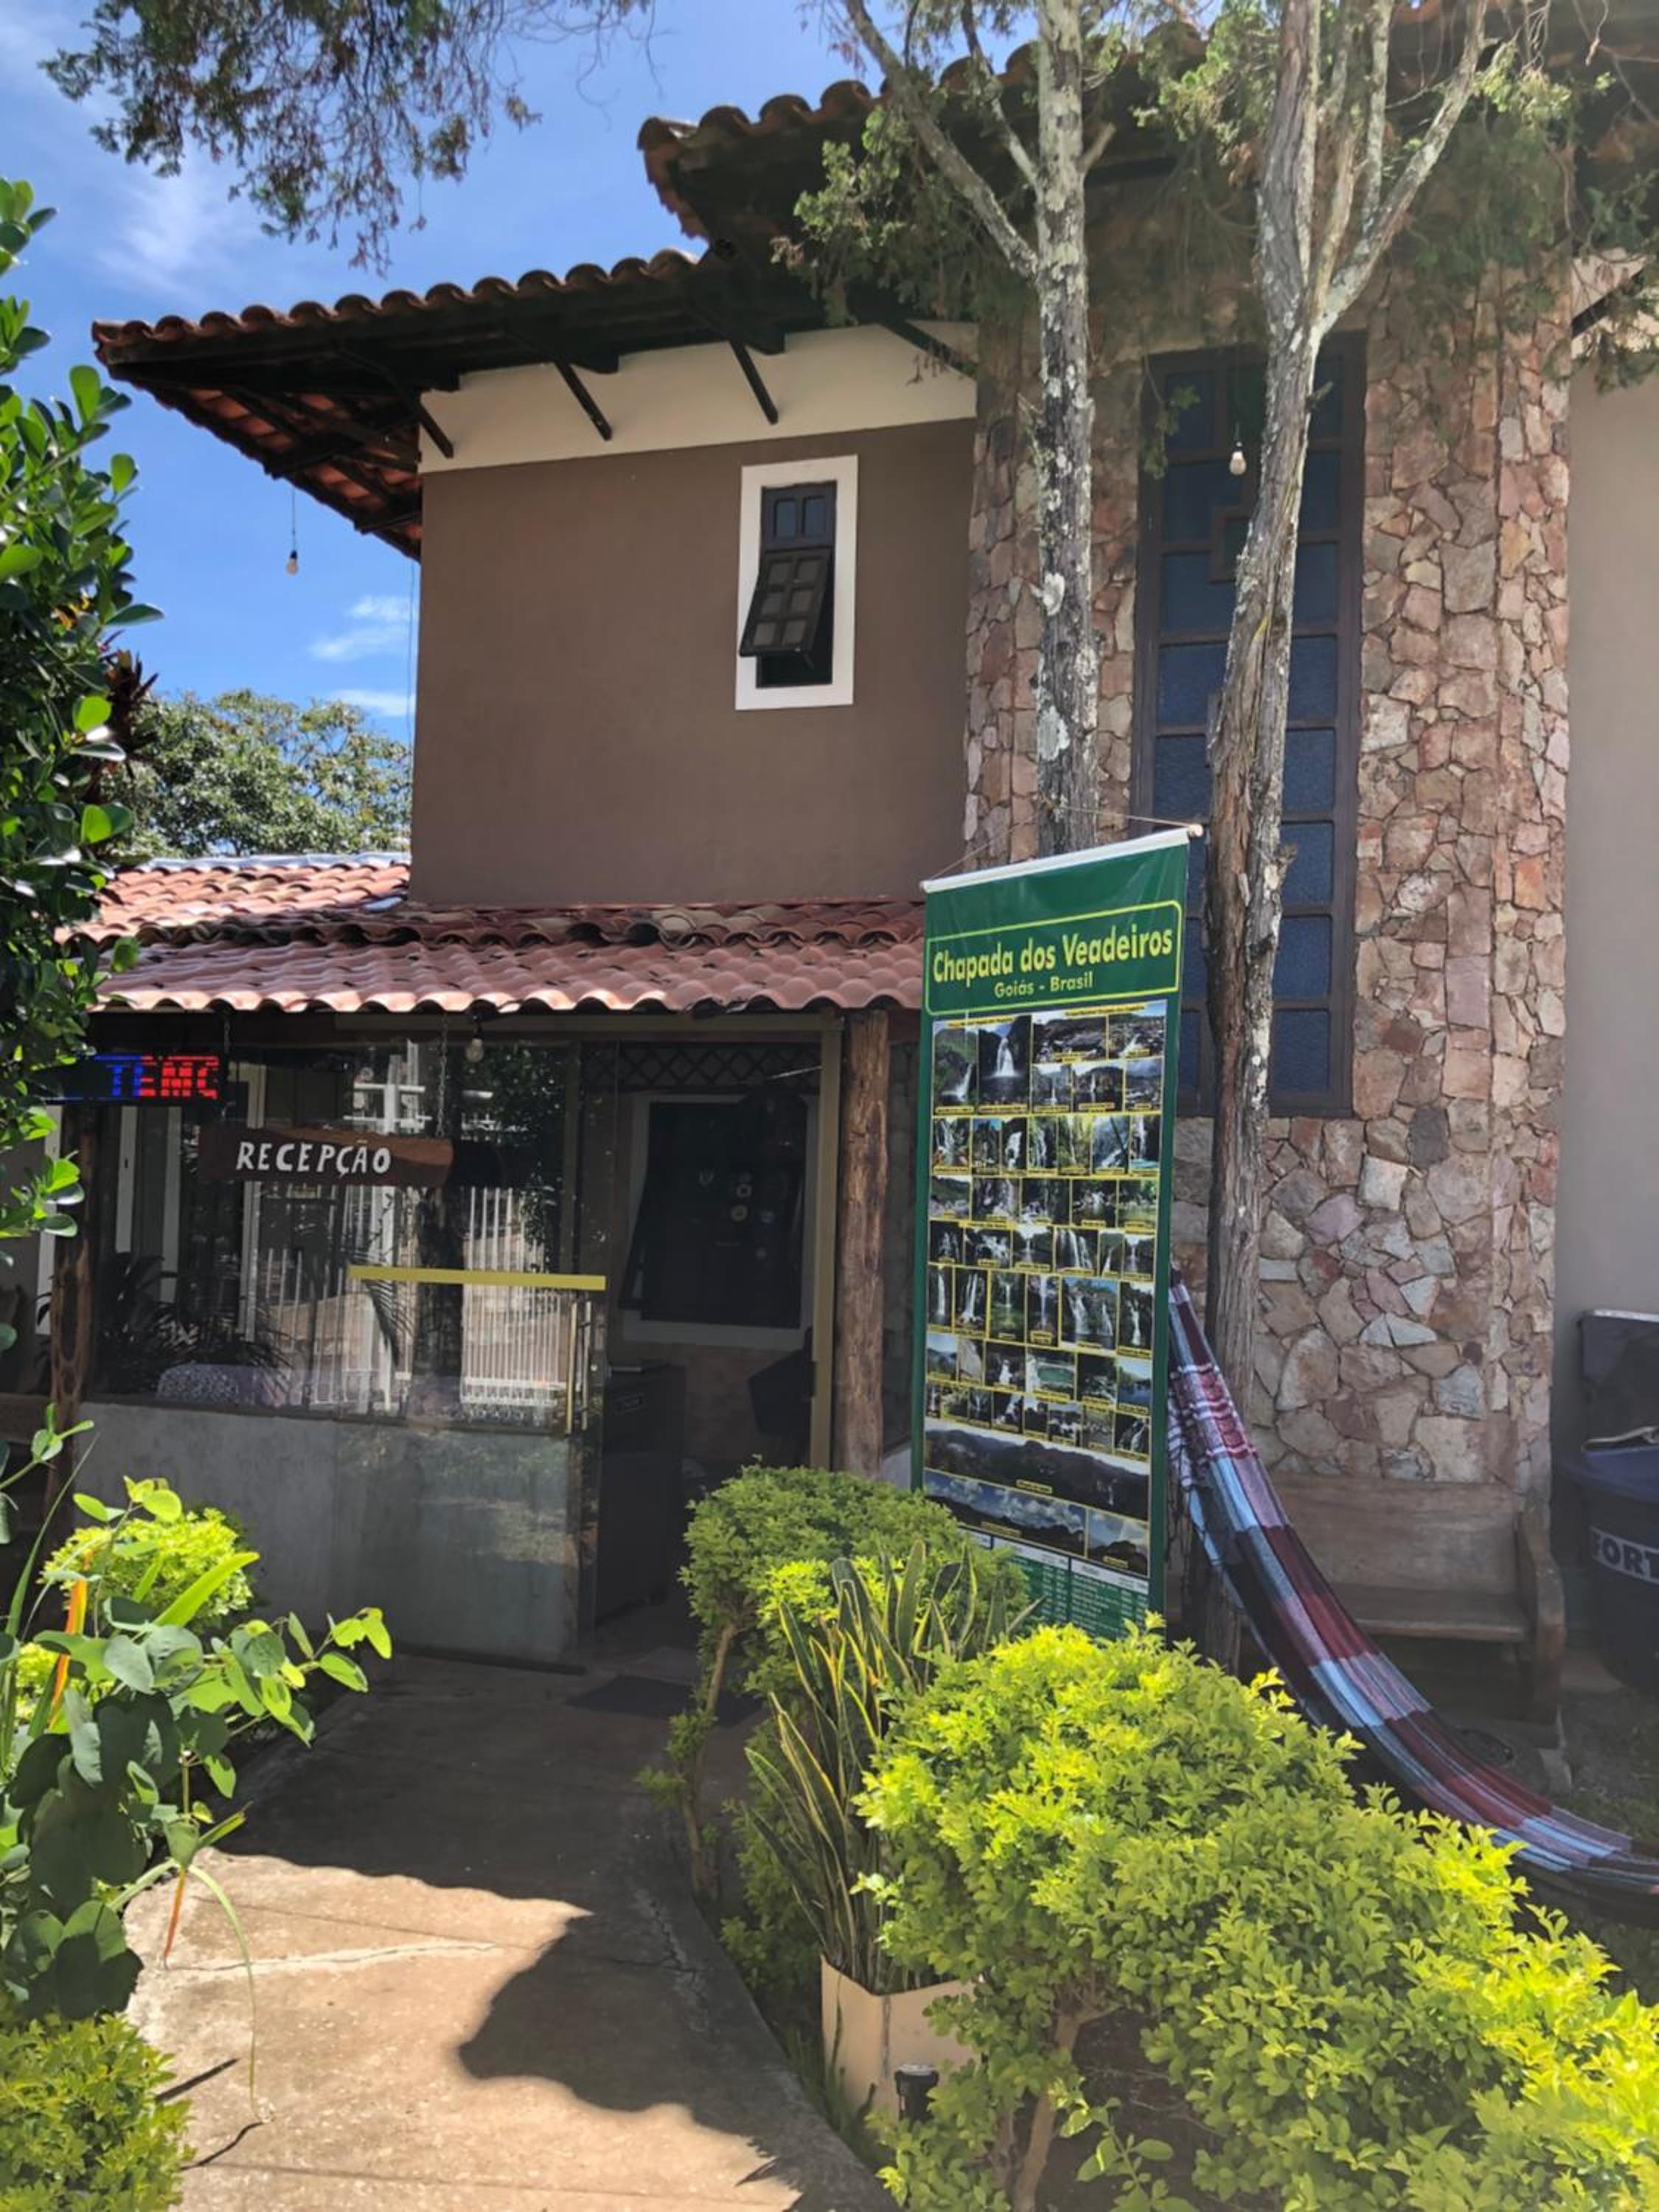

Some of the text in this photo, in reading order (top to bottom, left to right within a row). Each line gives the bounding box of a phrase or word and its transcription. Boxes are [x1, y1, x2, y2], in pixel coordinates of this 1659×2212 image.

[933, 923, 1172, 988] Chapada dos Veadeiros
[994, 979, 1034, 998] Goiás
[1050, 970, 1093, 992] Brasil
[235, 1138, 392, 1178] RECEPÇÃO
